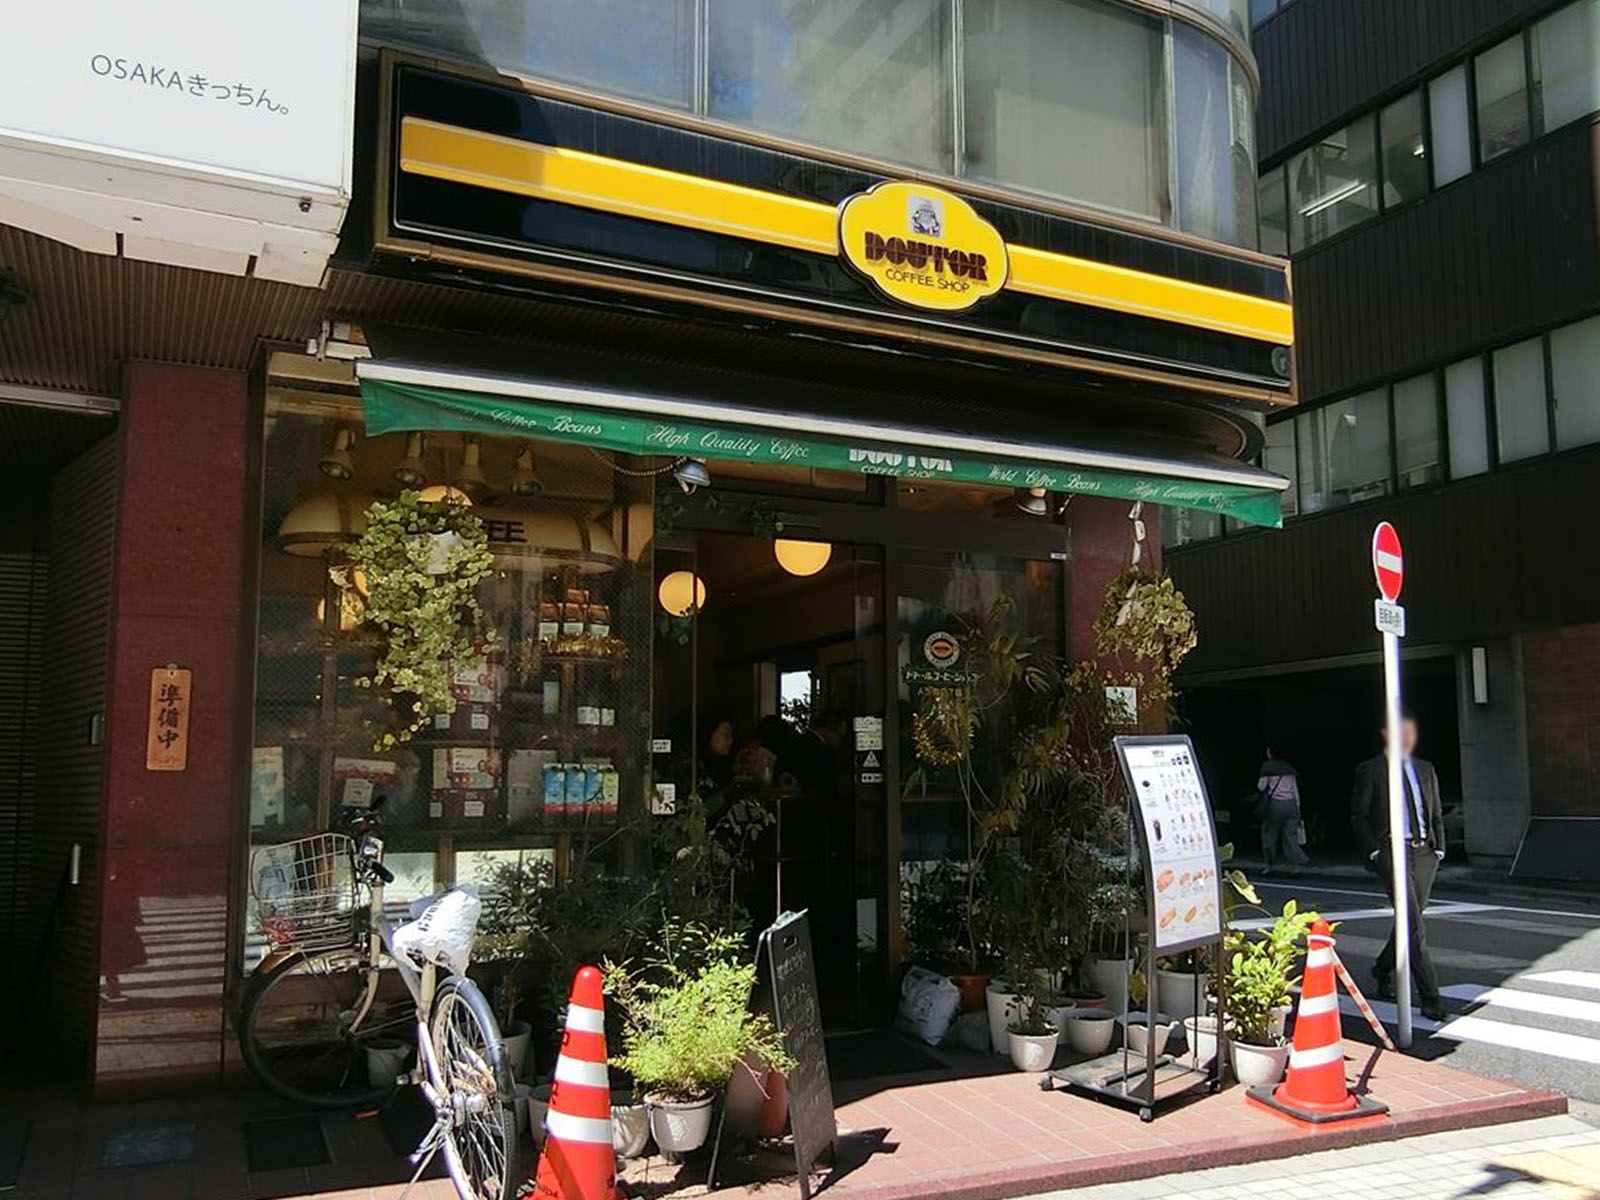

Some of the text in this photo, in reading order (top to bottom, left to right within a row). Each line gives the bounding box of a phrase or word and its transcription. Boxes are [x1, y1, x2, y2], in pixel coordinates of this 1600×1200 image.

[91, 54, 290, 116] OSAKAきっちん。
[864, 231, 988, 282] DOUTOR
[885, 268, 970, 294] COFFEE SHOP
[548, 414, 603, 436] Beans
[646, 424, 809, 461] High Quality Coffee
[860, 465, 936, 479] COFFEE SHOP
[1063, 473, 1104, 491] Beans
[158, 683, 182, 749] 準備中
